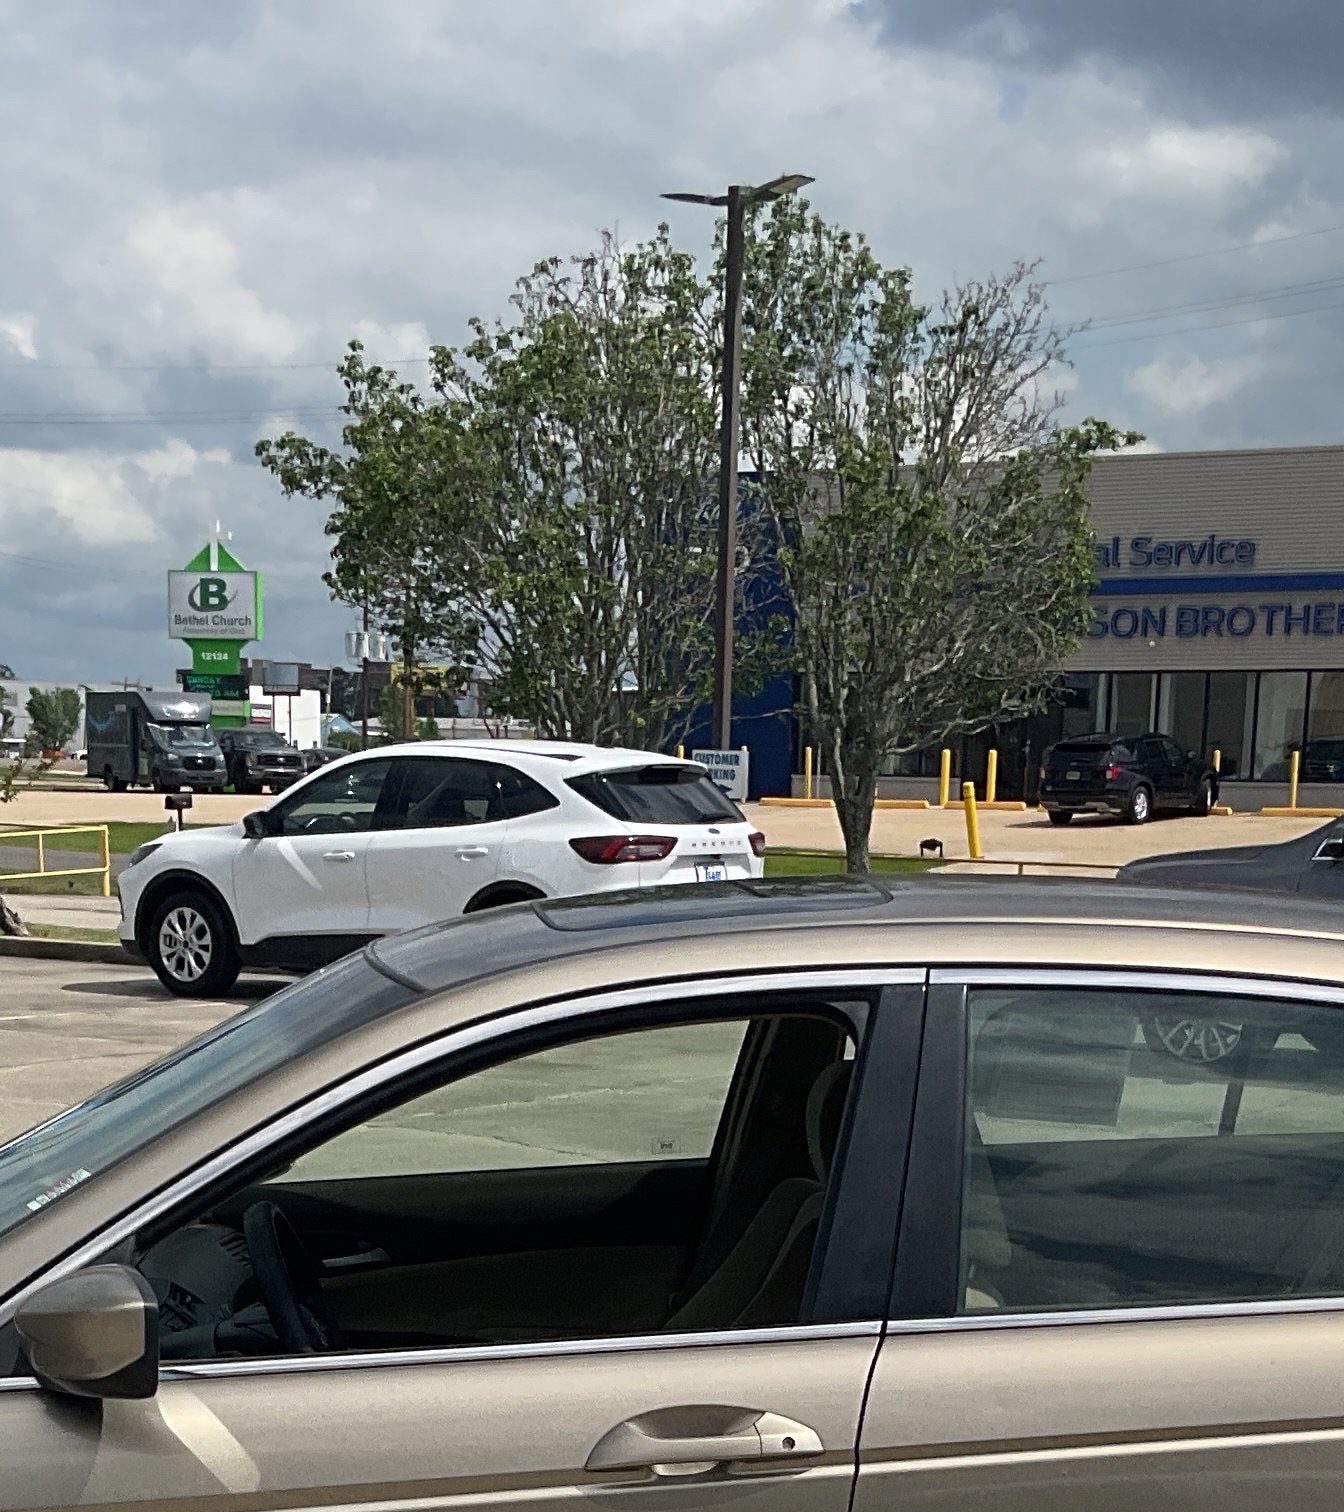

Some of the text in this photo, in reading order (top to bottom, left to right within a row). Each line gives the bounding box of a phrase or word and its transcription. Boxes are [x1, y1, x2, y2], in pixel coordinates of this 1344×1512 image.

[1130, 534, 1256, 568] Service
[212, 614, 252, 627] Church
[695, 752, 739, 767] CUSTOMER
